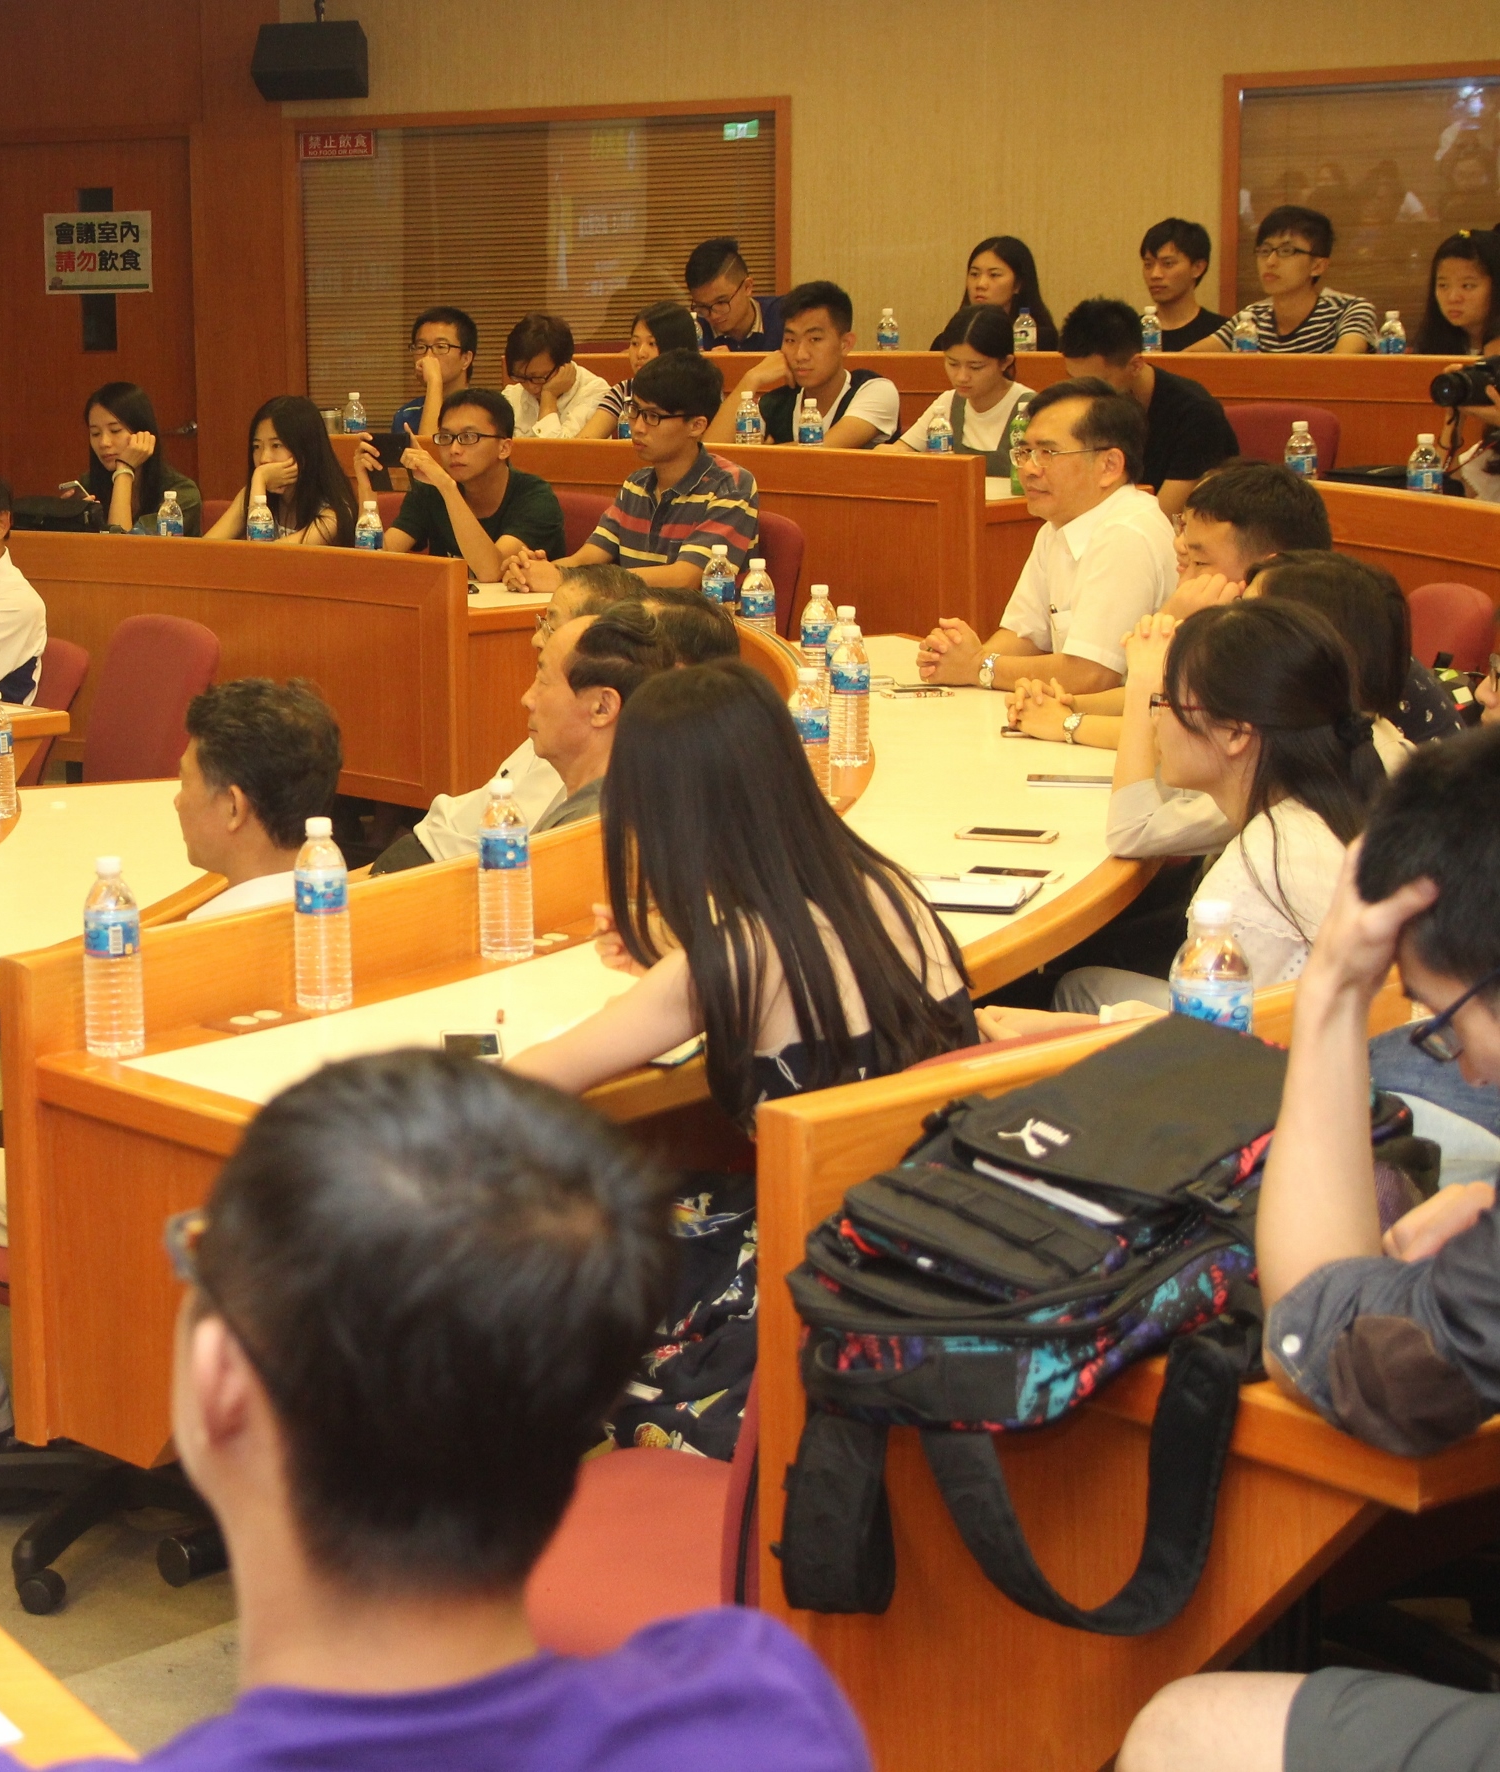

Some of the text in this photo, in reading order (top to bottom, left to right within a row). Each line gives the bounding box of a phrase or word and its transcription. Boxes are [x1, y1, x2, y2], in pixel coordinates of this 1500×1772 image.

[308, 133, 368, 149] 禁止飲食
[55, 221, 140, 244] 會議室內
[55, 249, 141, 272] 請勿飲食
